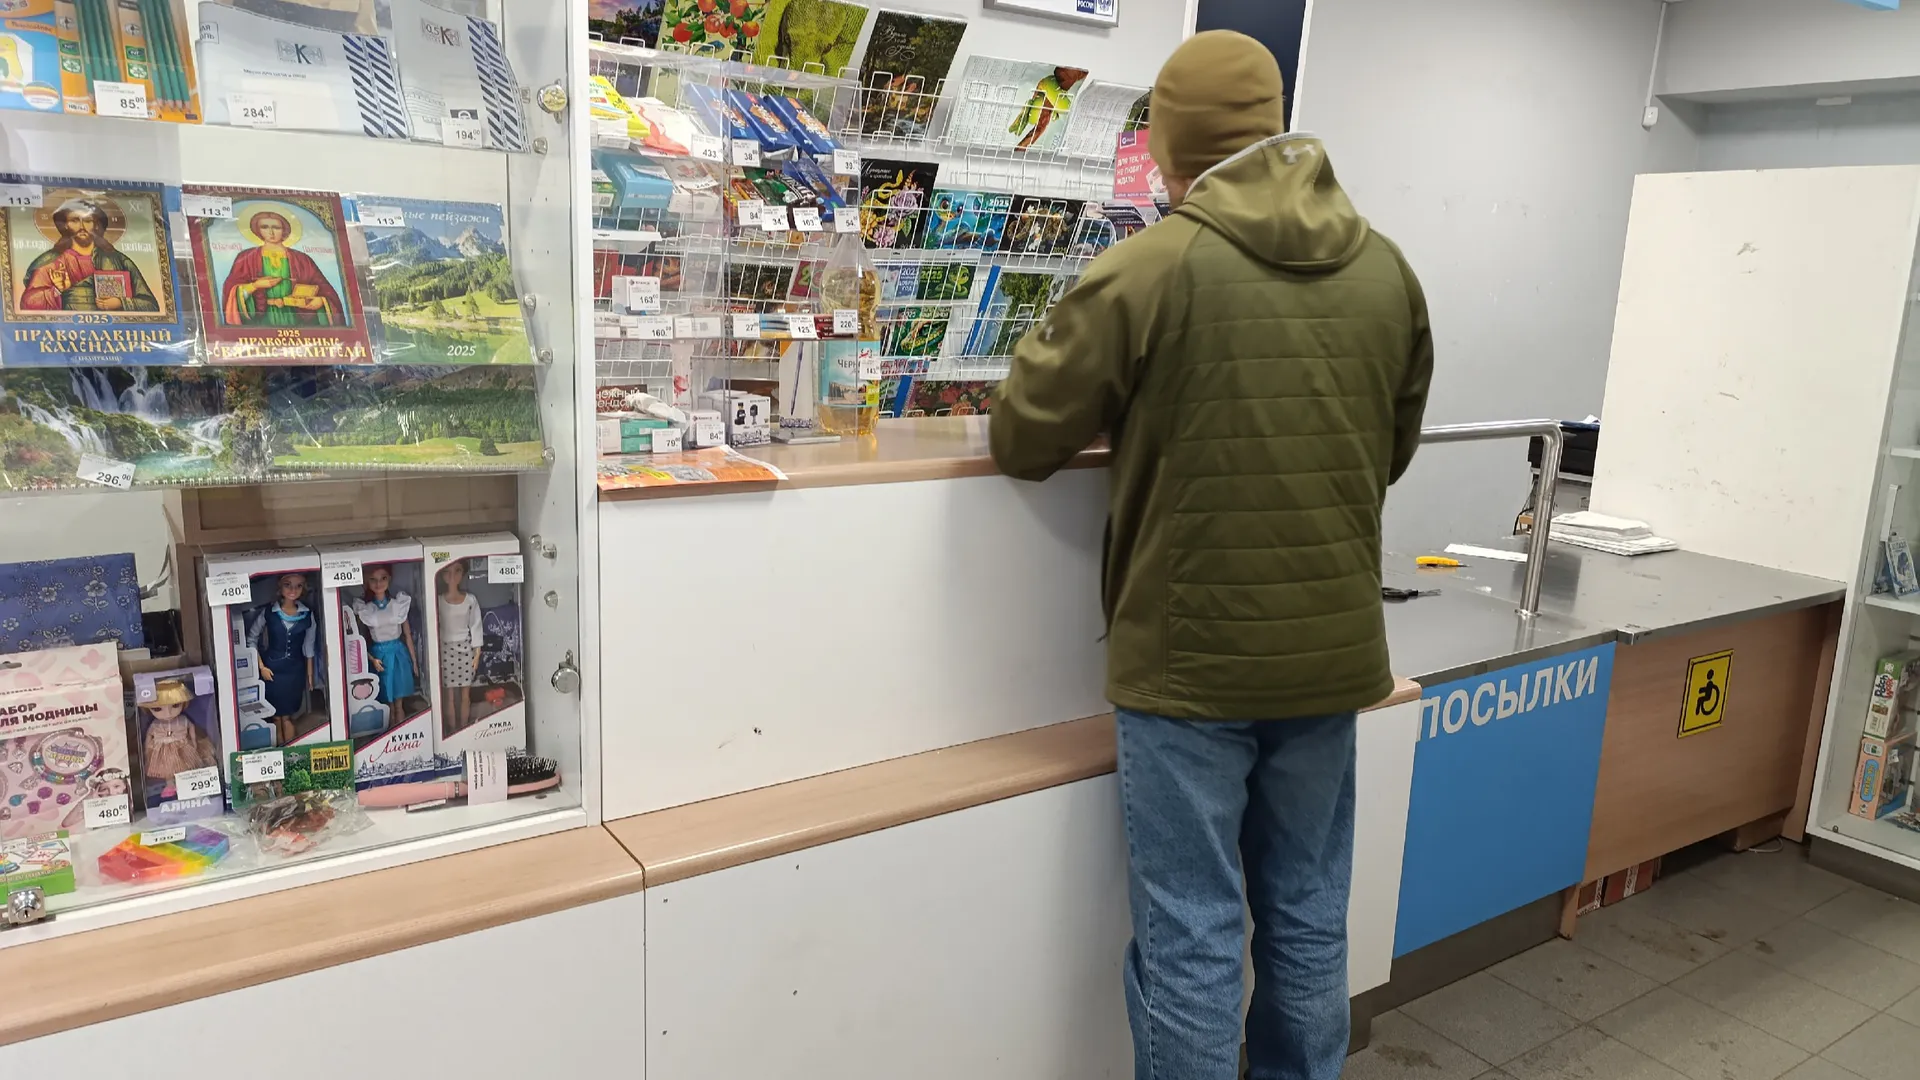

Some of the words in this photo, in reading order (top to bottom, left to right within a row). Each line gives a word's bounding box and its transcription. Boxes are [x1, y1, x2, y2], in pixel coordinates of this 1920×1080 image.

[430, 213, 490, 226] пейзажи
[77, 315, 109, 324] 2025
[14, 328, 172, 342] ПРАВОСЛАВНЫЙ
[277, 329, 301, 338] 2025
[39, 340, 152, 354] КАЛЕНДАРЬ
[446, 344, 477, 357] 2025
[96, 472, 131, 488] 296.00
[333, 566, 360, 581] 480.00
[221, 583, 249, 597] 480.00
[1416, 655, 1599, 742] ПОСЫЛКИ
[0, 702, 37, 716] АБОР
[0, 716, 19, 728] ЛЯ
[23, 703, 99, 724] МОДНИЦЫ
[489, 721, 512, 730] КУКЛА
[391, 731, 425, 743] КУКЛА
[261, 760, 282, 776] 86.00
[190, 775, 218, 791] 299.00
[99, 804, 128, 820] 480.00
[160, 797, 212, 814] АЛИНА
